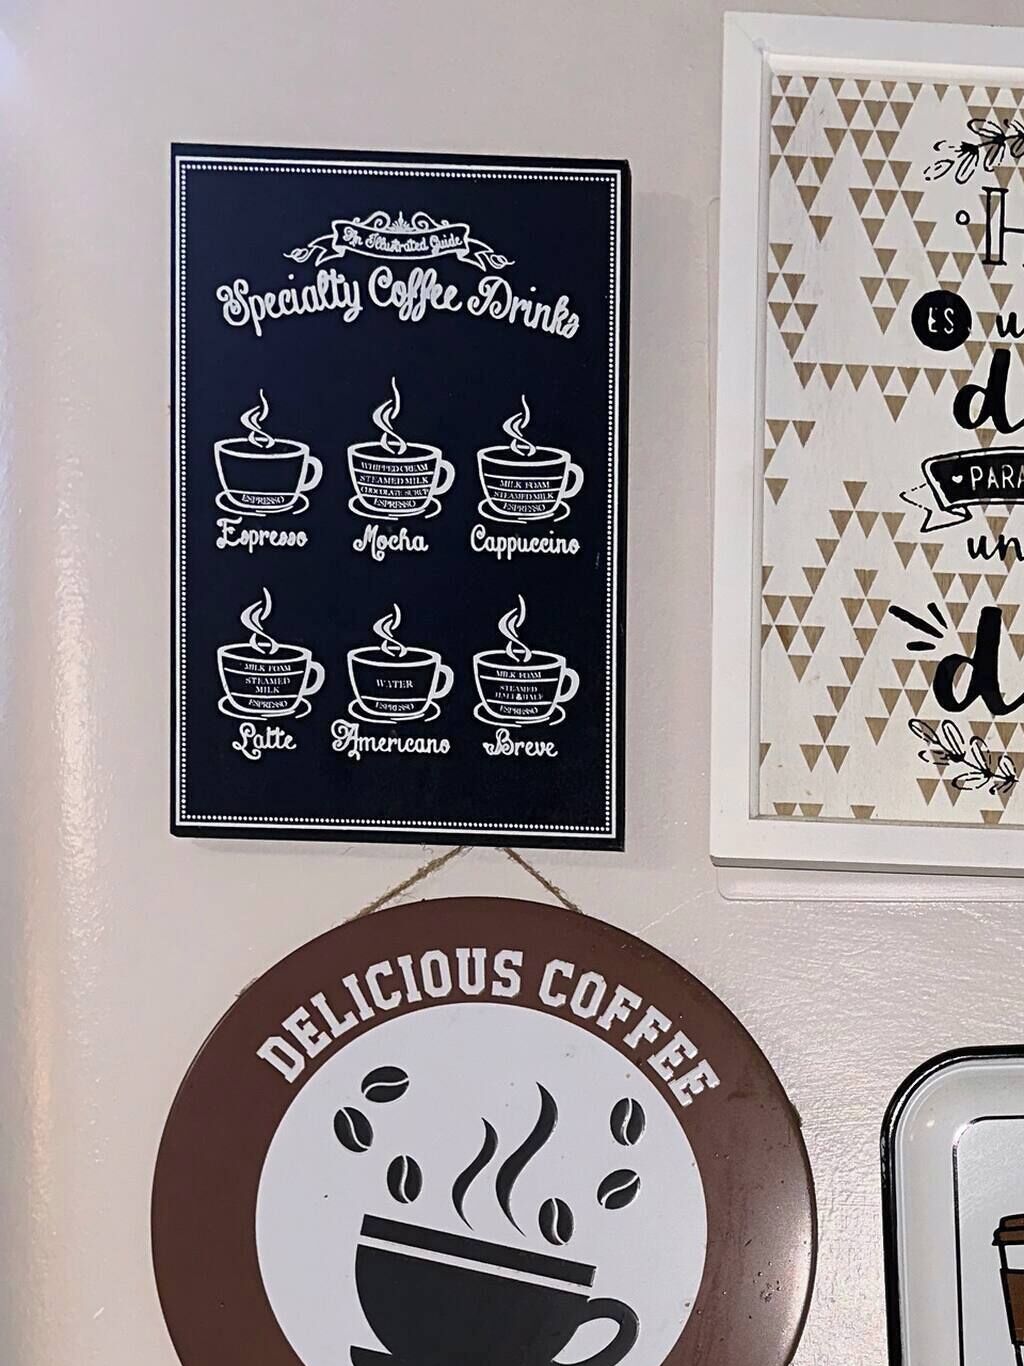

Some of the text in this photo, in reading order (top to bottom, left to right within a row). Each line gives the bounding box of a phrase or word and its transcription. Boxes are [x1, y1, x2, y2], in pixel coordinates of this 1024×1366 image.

[365, 233, 429, 253] Illustrated
[430, 233, 462, 255] Guide
[216, 265, 580, 339] Specialty Coffee Drinks
[927, 307, 955, 334] ES
[360, 475, 404, 485] STEAMED
[500, 479, 550, 489] MILK FOAM
[216, 516, 308, 554] Espresso
[352, 523, 429, 561] Mocha
[470, 523, 580, 560] Cappuccino
[244, 663, 291, 672] MILK FOAM
[496, 670, 542, 679] MILK FOAM
[245, 677, 291, 685] STEAMED
[255, 686, 280, 694] MILK
[376, 679, 414, 689] WATER
[500, 685, 538, 693] STEAMED
[232, 722, 297, 760] Latte
[331, 718, 450, 761] Americano
[482, 728, 558, 757] Breve
[255, 947, 721, 1108] DELICIOUS COFFEE
